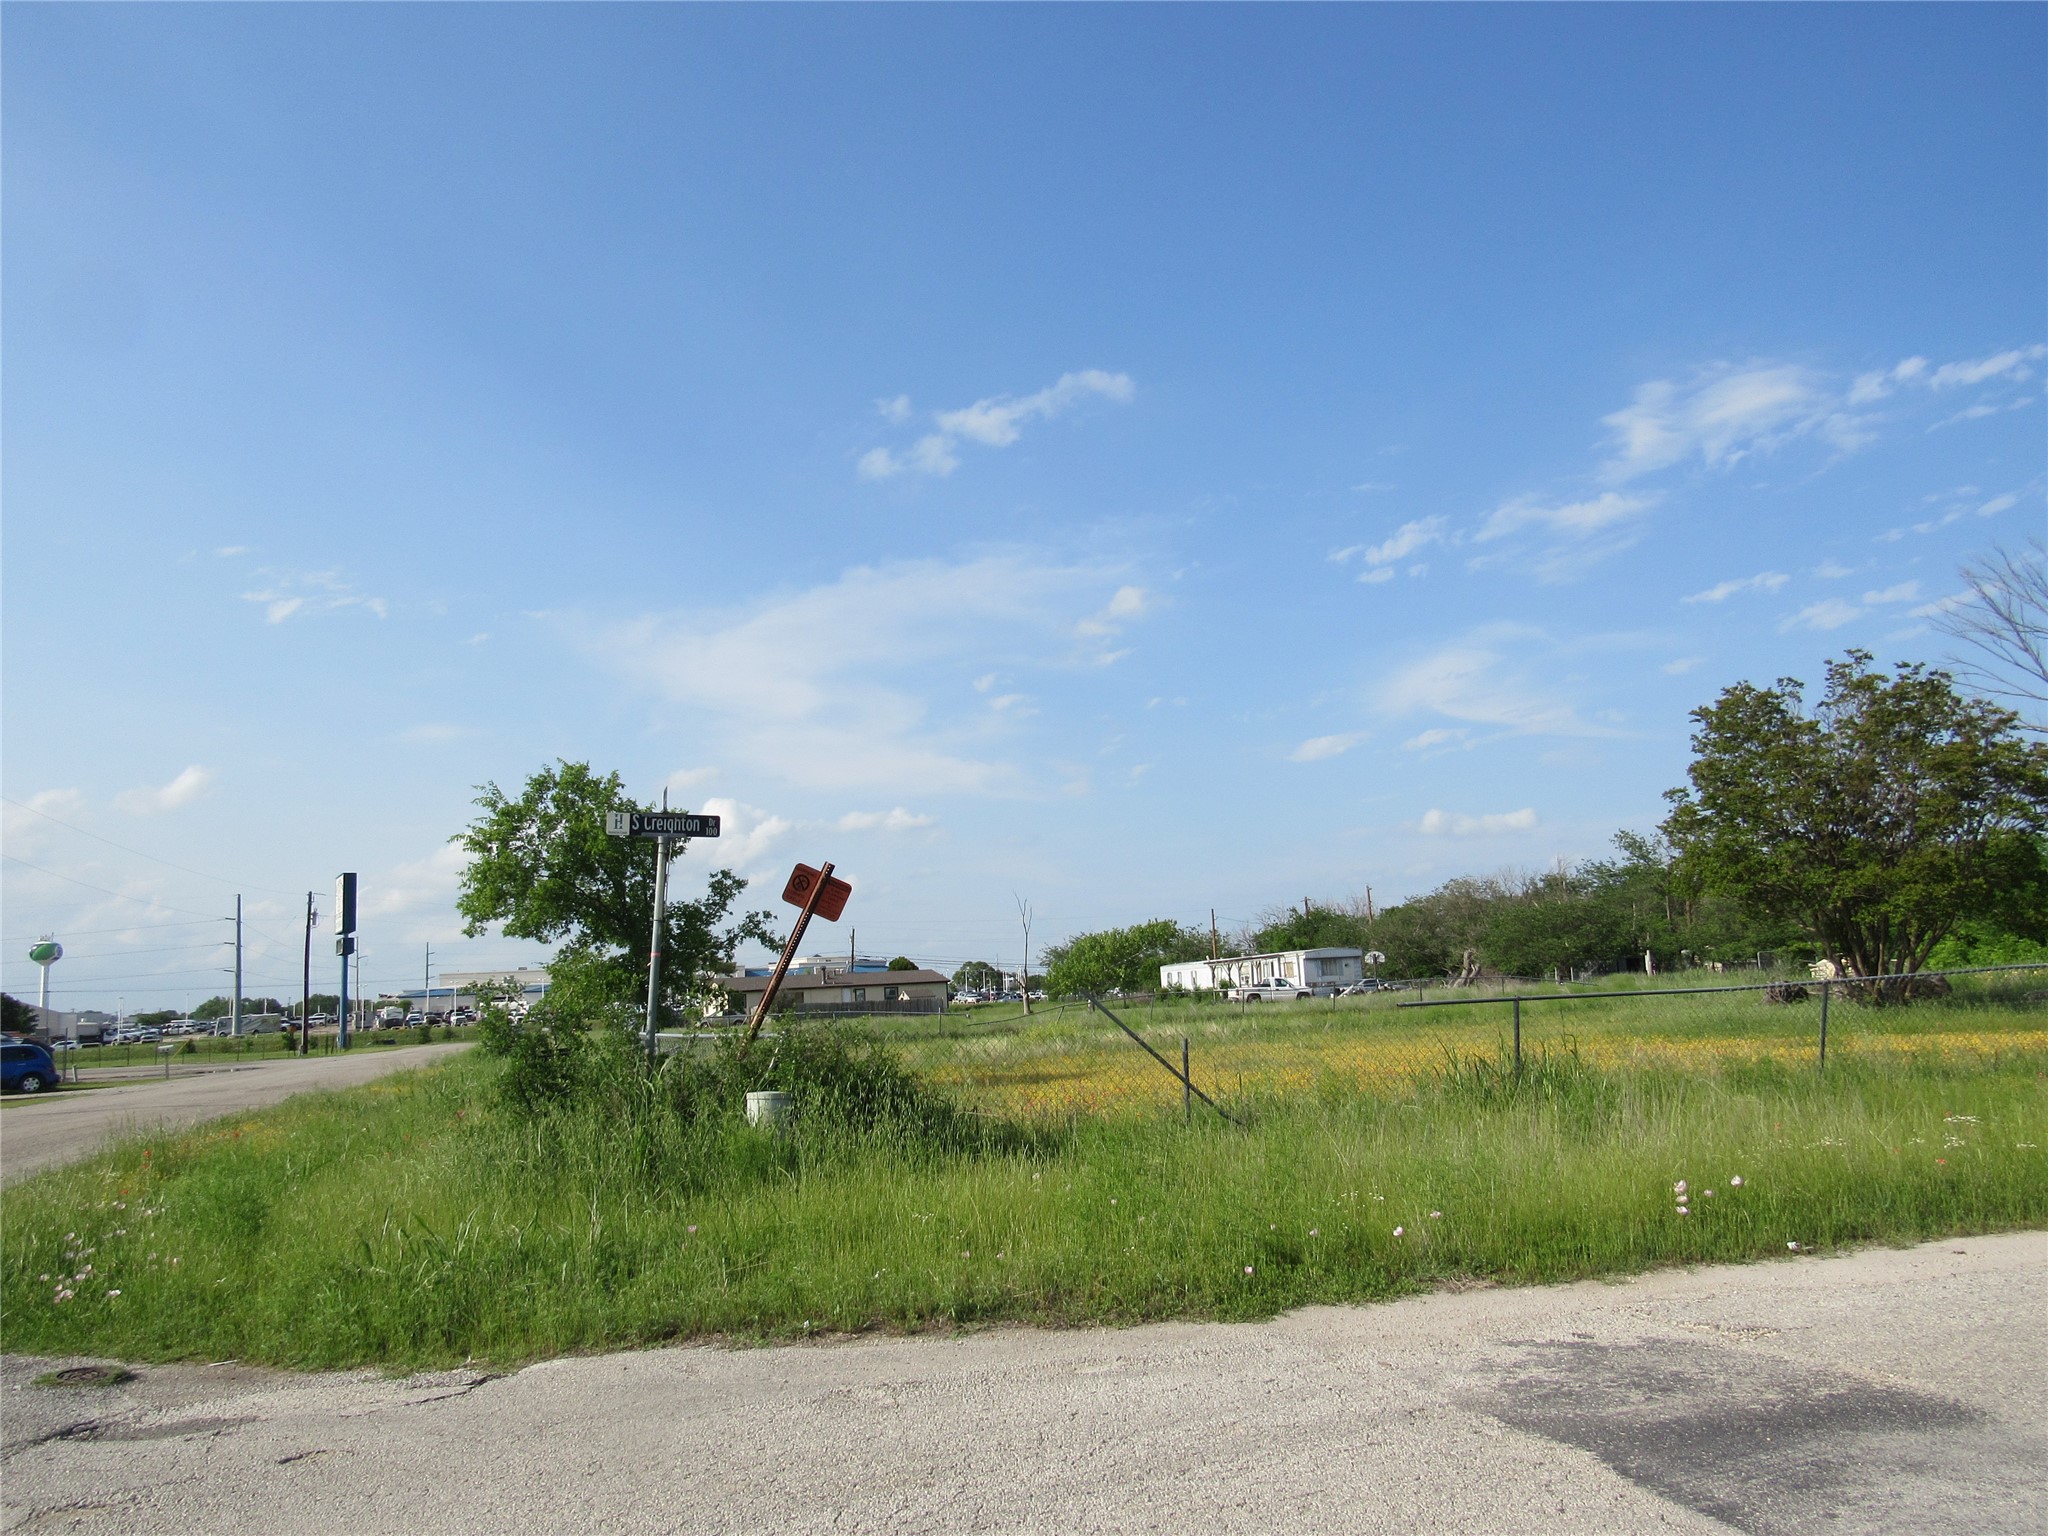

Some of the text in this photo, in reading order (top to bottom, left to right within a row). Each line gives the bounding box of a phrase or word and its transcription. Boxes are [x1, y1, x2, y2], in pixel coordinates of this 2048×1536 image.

[632, 814, 700, 833] S Creighton
[708, 818, 715, 826] Dr
[705, 827, 718, 836] 100
